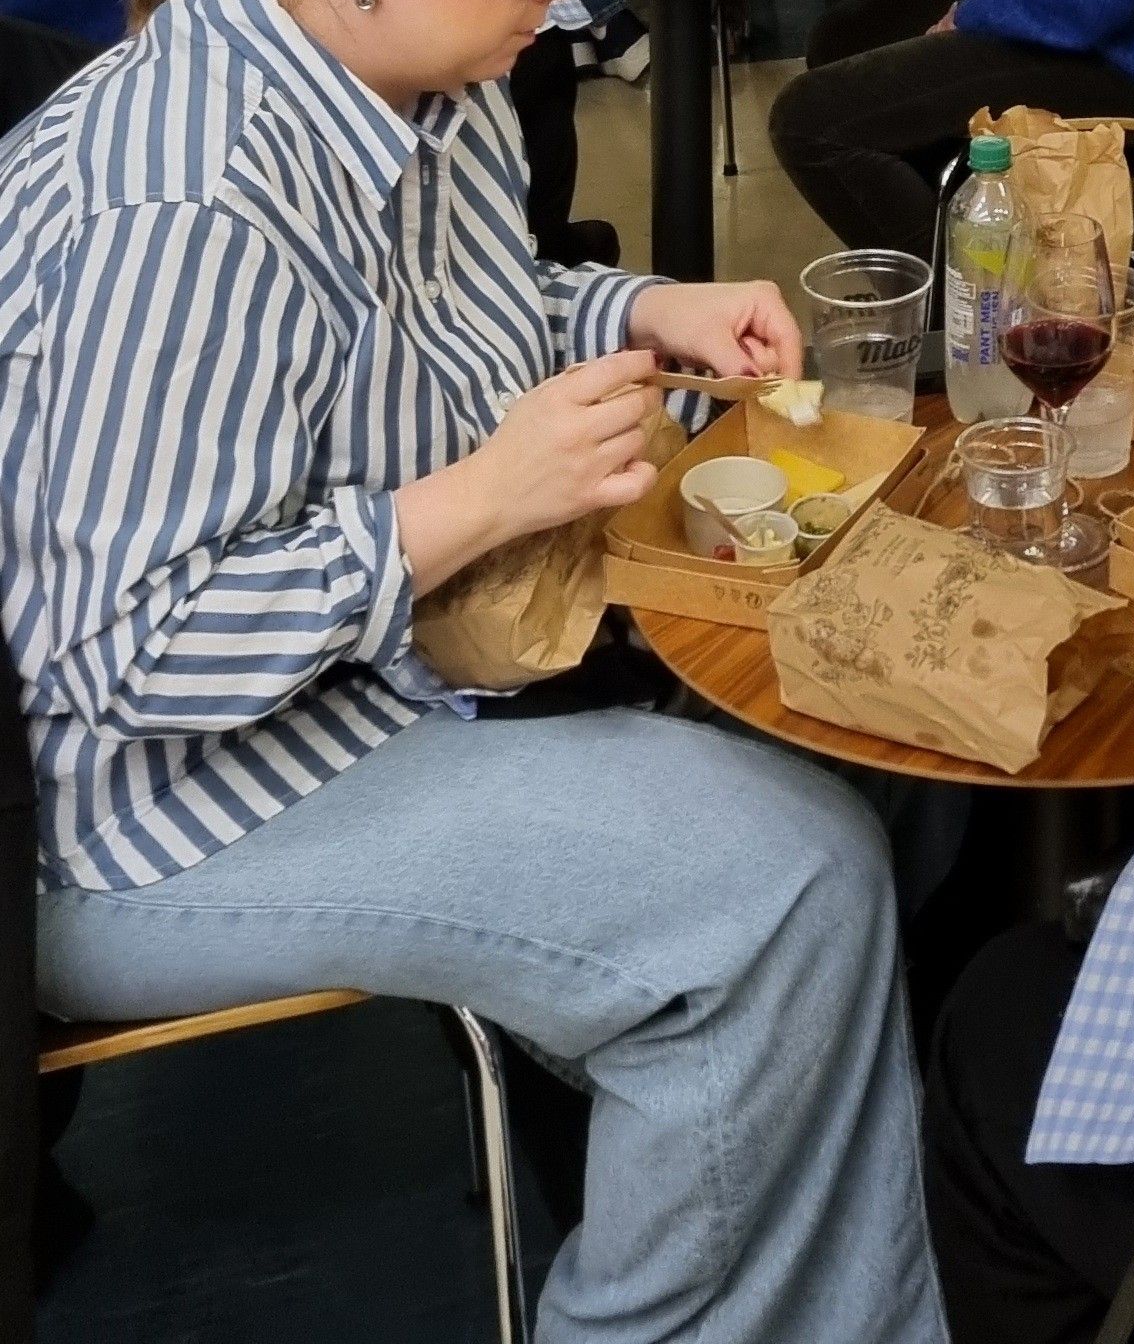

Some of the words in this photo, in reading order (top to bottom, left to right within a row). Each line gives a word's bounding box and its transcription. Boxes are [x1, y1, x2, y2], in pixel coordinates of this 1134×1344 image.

[980, 291, 991, 323] MEG
[857, 334, 922, 365] Mac
[980, 329, 991, 365] PANT
